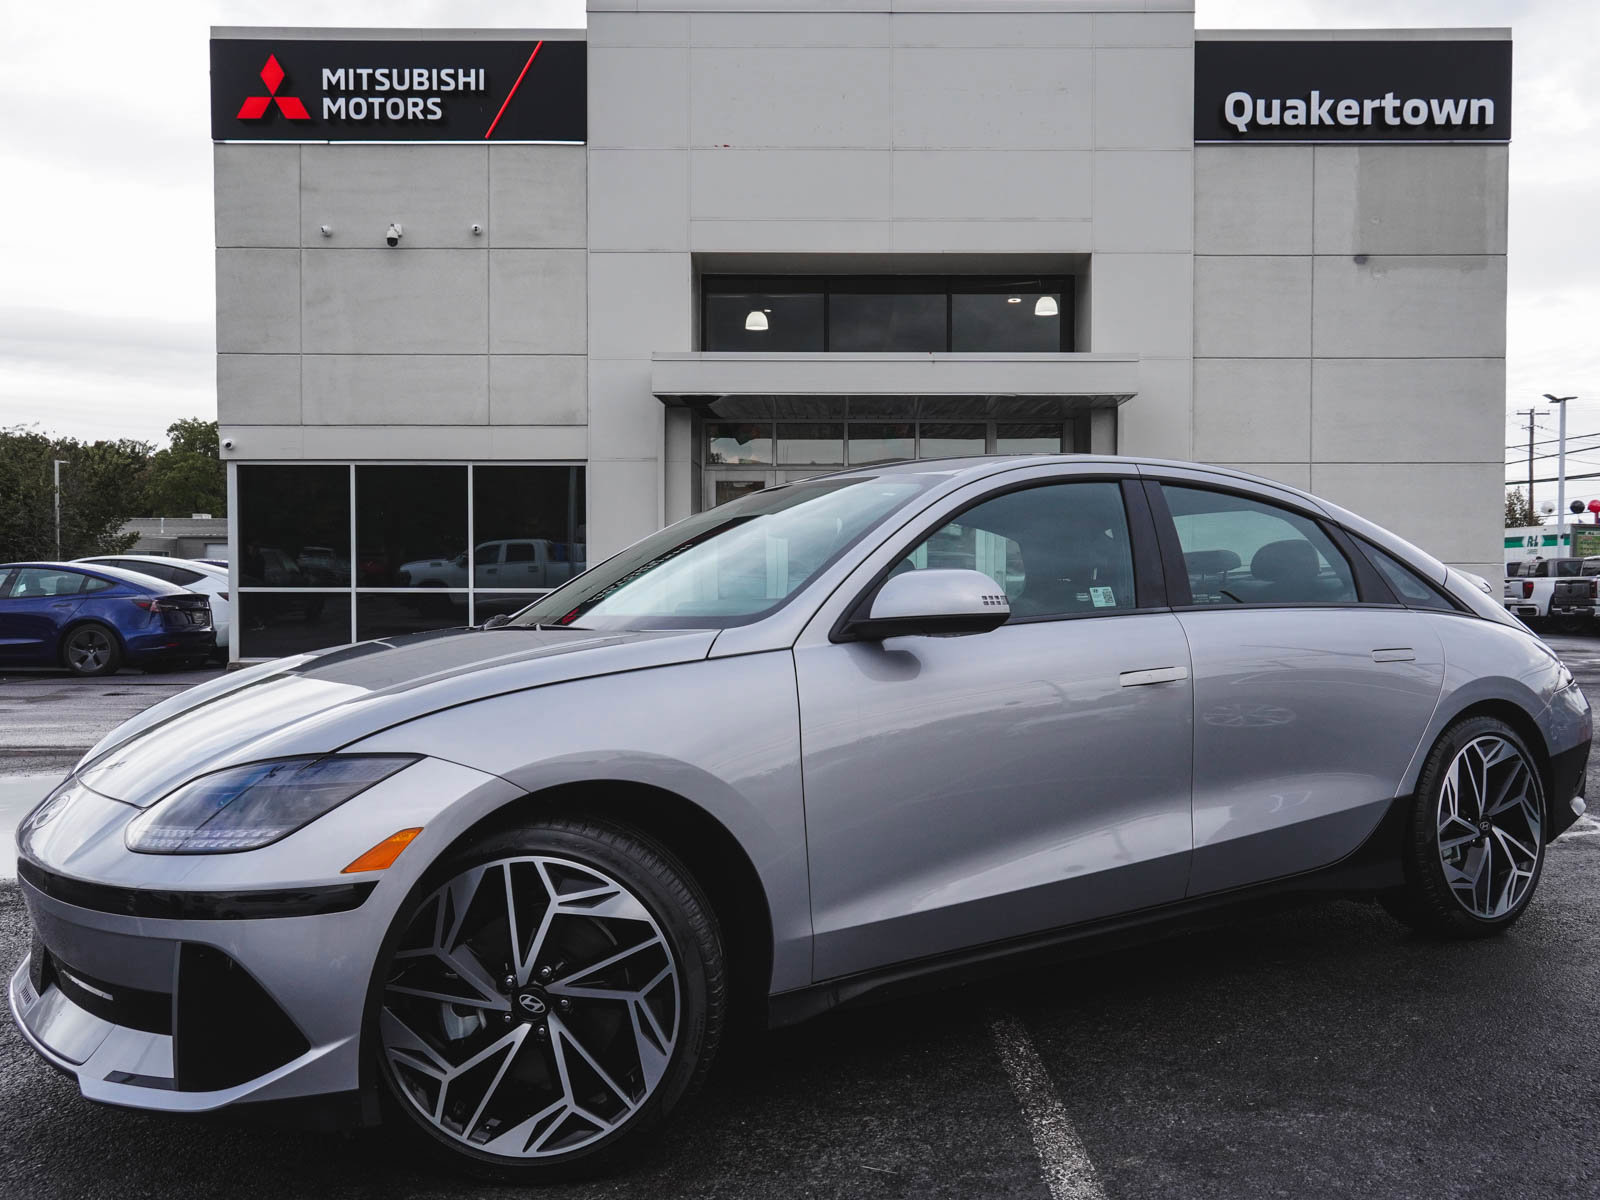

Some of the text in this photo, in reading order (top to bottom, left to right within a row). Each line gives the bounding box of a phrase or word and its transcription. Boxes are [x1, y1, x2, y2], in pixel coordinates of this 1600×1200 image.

[322, 68, 485, 91] MITSUBISHI
[322, 97, 443, 120] MOTORS
[1224, 90, 1495, 132] Quakertown
